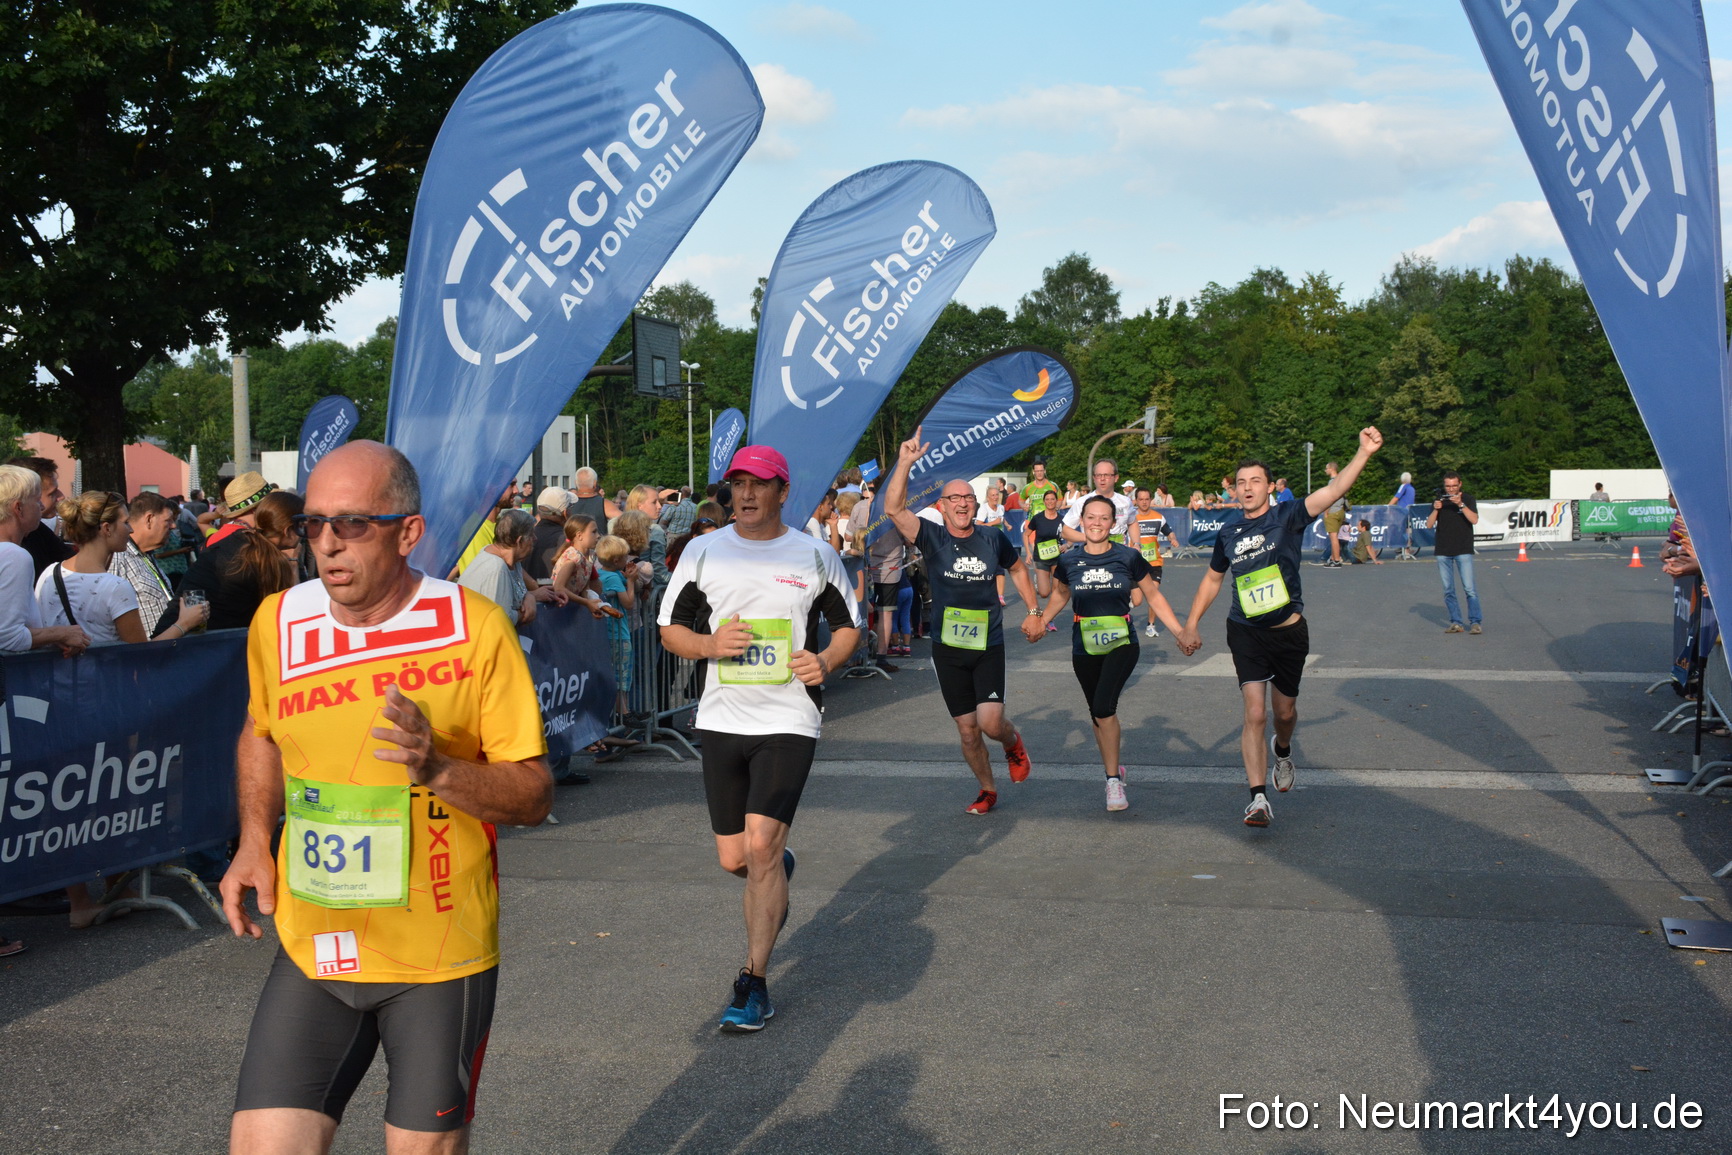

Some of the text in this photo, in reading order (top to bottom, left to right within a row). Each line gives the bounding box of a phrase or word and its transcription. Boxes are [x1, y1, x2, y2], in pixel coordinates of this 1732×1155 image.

[490, 68, 686, 322] Fischer
[558, 118, 707, 321] AUTOMOBILE
[812, 199, 942, 379] Fischer
[857, 231, 957, 376] AUTOMOBILE
[311, 408, 347, 463] Fischer
[717, 418, 738, 463] Fischer
[982, 396, 1068, 449] Druck und Medien
[1508, 510, 1548, 530] swn
[1586, 505, 1618, 522] AOK
[1041, 546, 1058, 556] 1153
[1248, 583, 1275, 604] 177
[952, 623, 979, 638] 174
[1092, 632, 1119, 646] 165
[731, 645, 777, 667] 406
[277, 657, 474, 720] MAX BÖGL
[534, 667, 590, 713] cher
[303, 829, 371, 874] 831
[329, 882, 368, 891] Gerhardt
